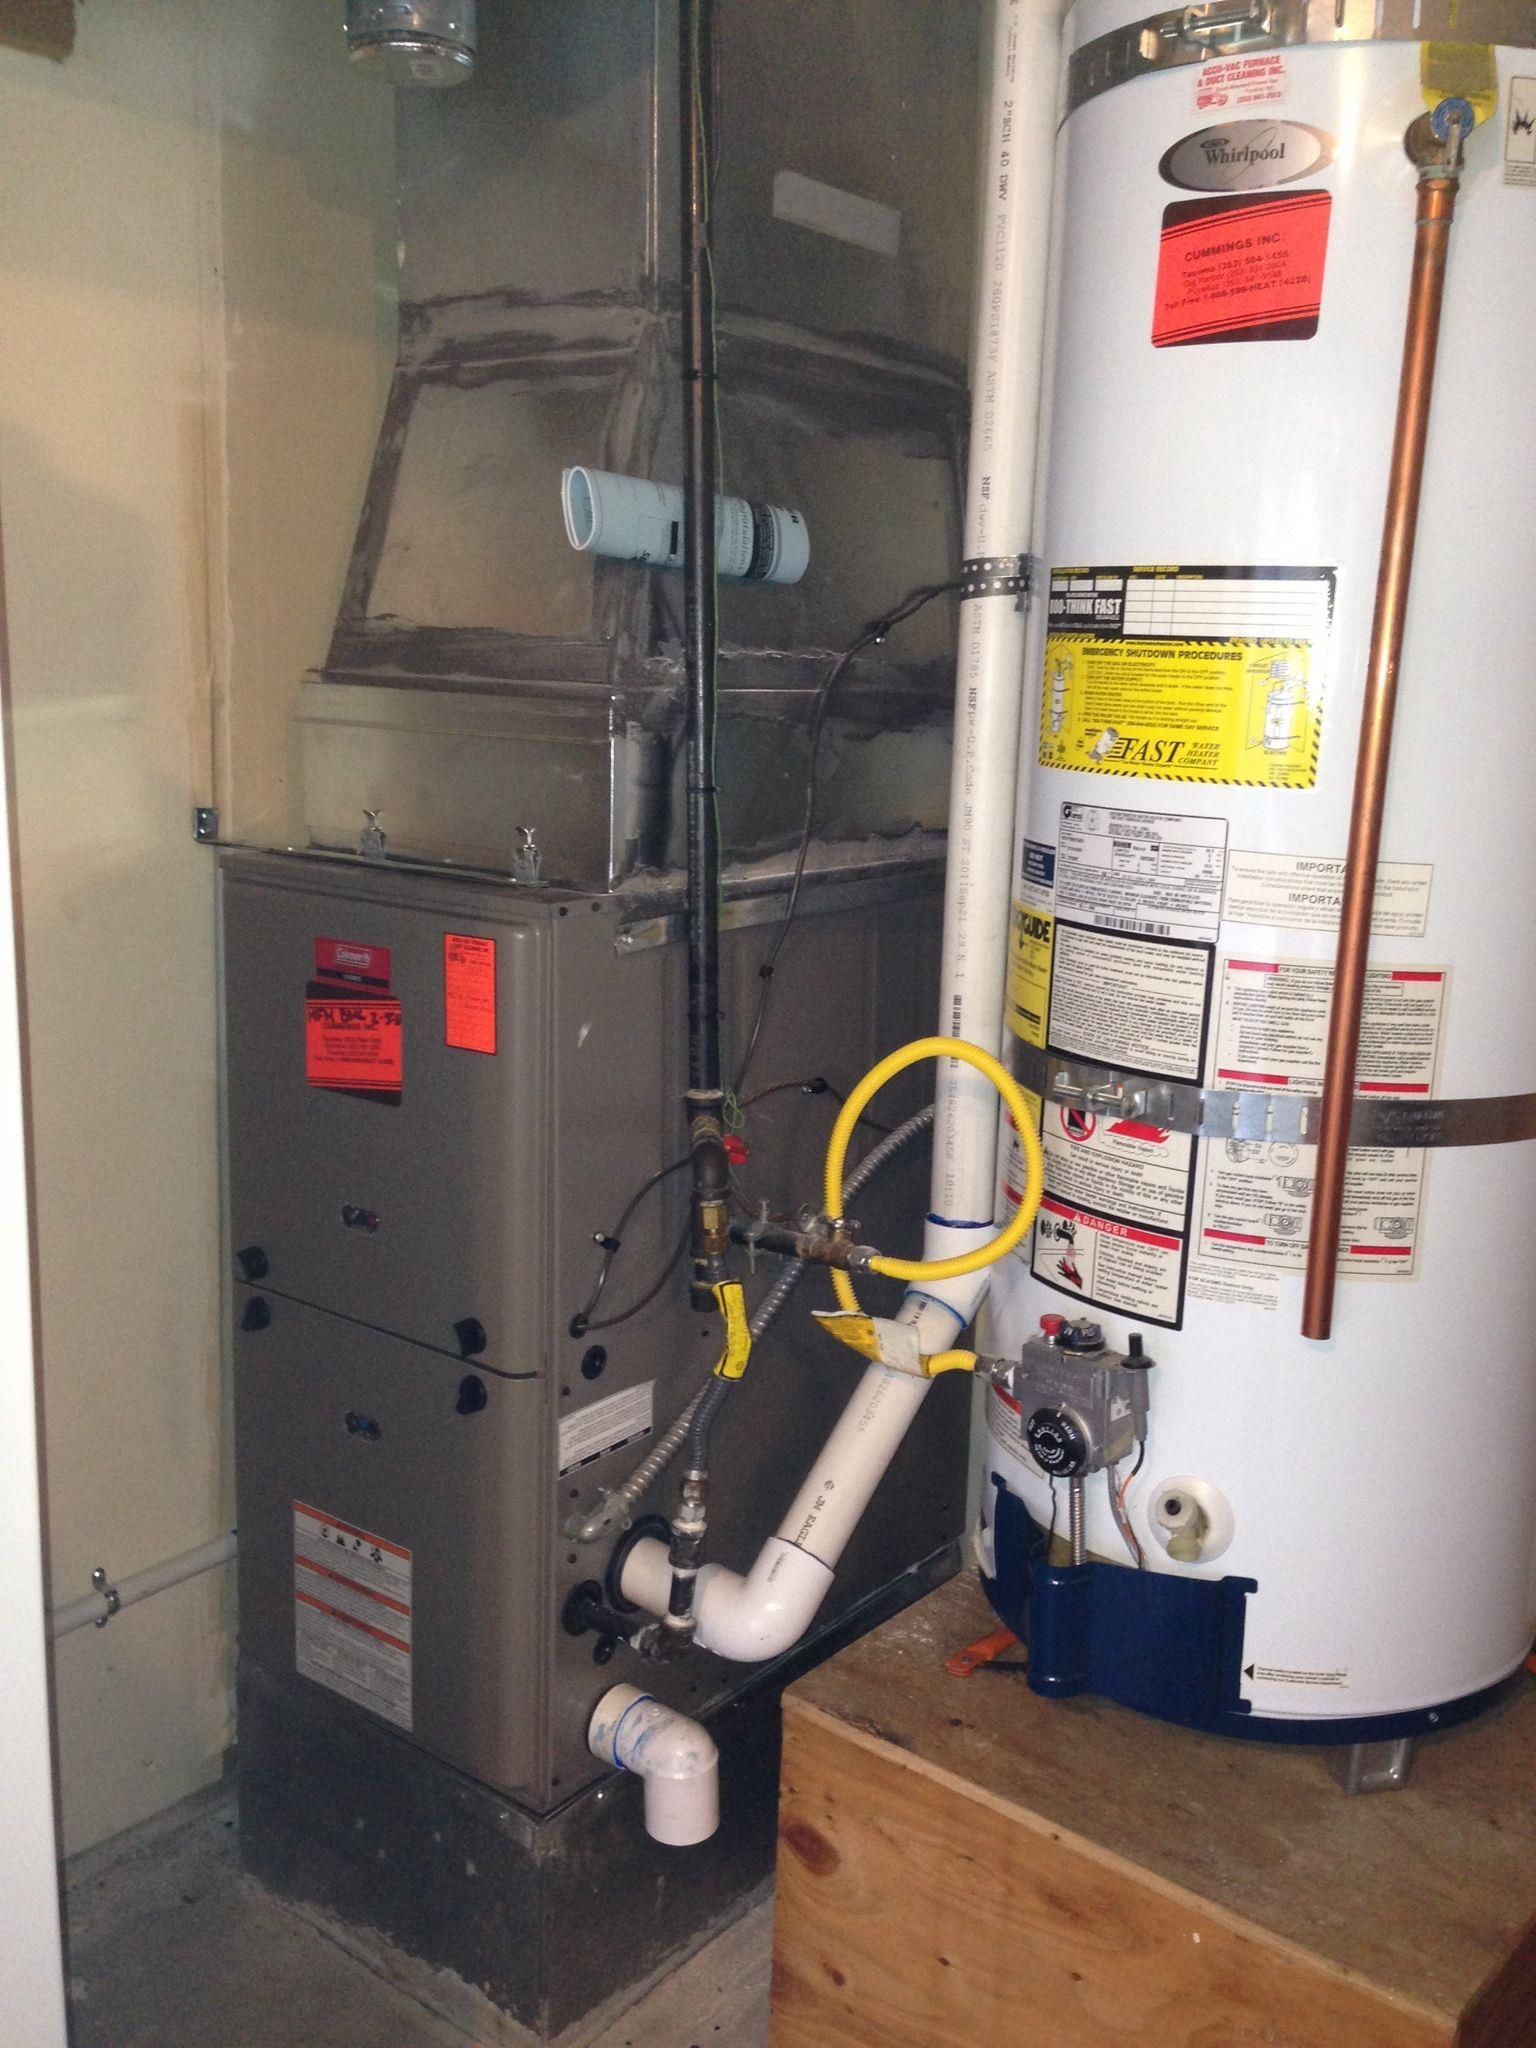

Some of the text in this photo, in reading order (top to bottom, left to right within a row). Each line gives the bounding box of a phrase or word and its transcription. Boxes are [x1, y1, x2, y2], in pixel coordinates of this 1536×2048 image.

[1000, 150, 1011, 168] 40
[1205, 143, 1286, 167] Whirlpool
[1184, 239, 1253, 263] CUMMINGS
[1094, 598, 1122, 615] FAST
[1082, 647, 1243, 662] EMERGENCY SHUTDOWN PROCEDURES
[1117, 737, 1186, 763] FAST
[1186, 750, 1221, 759] HEATER
[1192, 742, 1221, 751] WATER
[1178, 757, 1219, 767] COMPANY
[1296, 861, 1346, 875] IMPORTA
[1288, 893, 1342, 906] IMPORTA
[1082, 1215, 1129, 1237] DANGER
